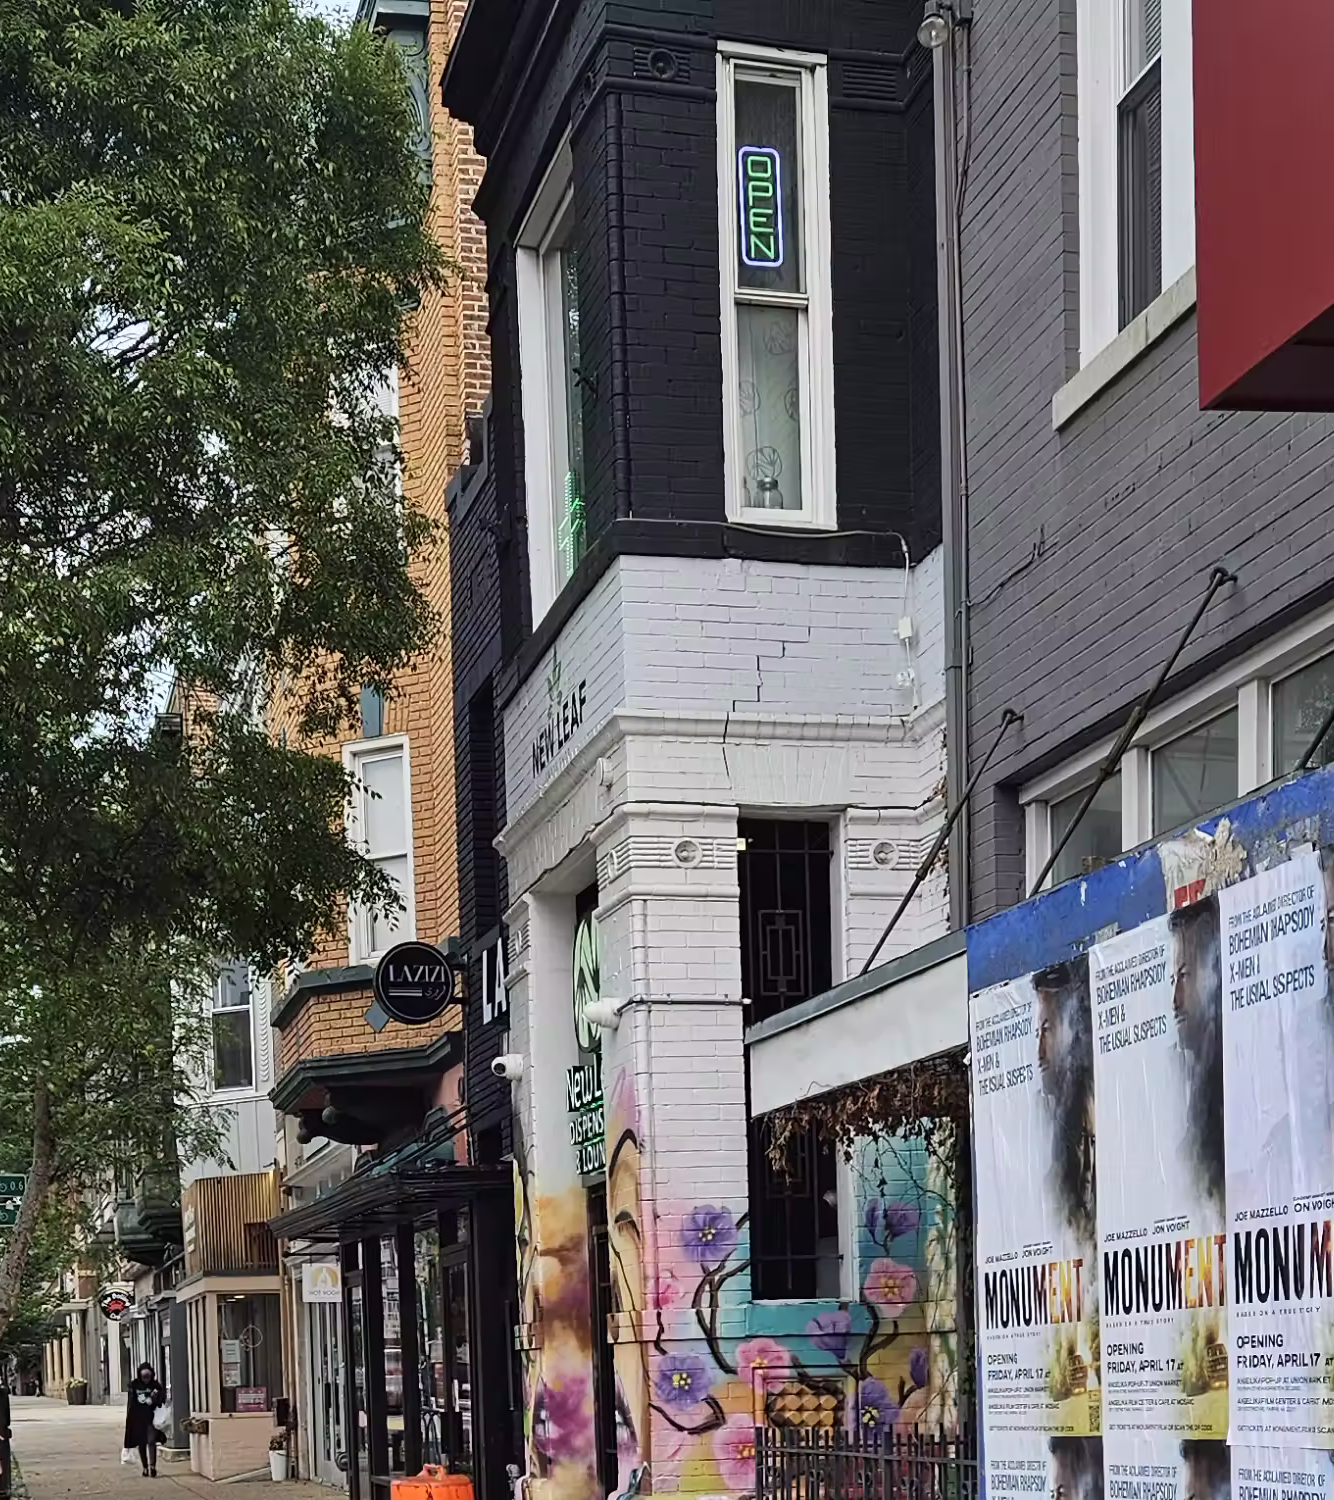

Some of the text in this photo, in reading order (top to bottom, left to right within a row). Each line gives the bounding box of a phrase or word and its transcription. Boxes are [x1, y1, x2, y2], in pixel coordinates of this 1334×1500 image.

[747, 156, 774, 259] OPEN
[533, 717, 554, 779] NEW
[557, 679, 586, 750] LEAF
[389, 965, 445, 982] LAZIZI
[1112, 1014, 1167, 1052] USUAL SUSPECTS
[10, 1182, 23, 1190] 0.6
[1104, 1234, 1226, 1316] MONUMENT
[984, 1258, 1083, 1329] MONUMENT
[1106, 1342, 1144, 1357] OPENING
[1236, 1334, 1284, 1349] OPENING
[987, 1353, 1018, 1365] OPENING
[1237, 1354, 1274, 1369] FRIDAY,
